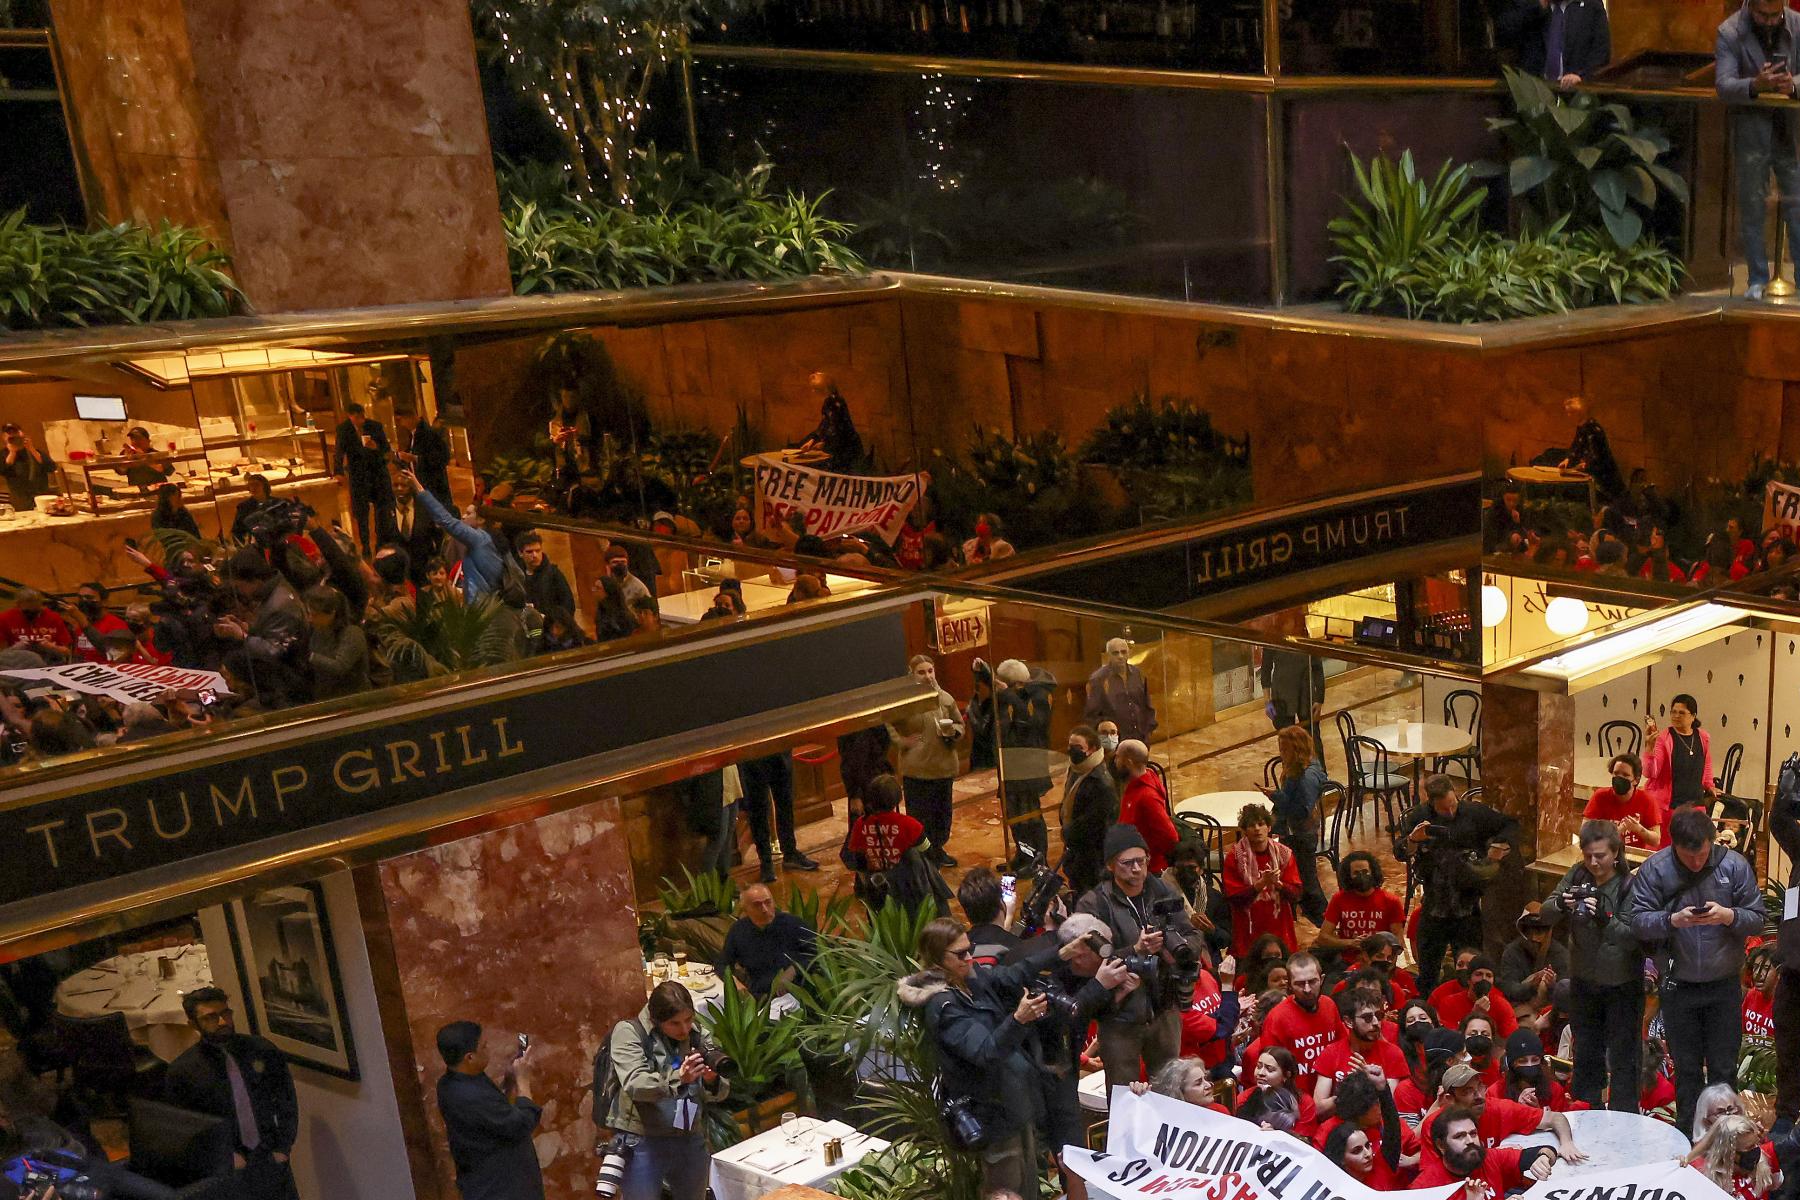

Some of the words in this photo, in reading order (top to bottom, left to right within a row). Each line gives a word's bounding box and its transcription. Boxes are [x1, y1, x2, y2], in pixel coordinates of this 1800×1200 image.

[756, 463, 807, 502] FREE
[941, 622, 972, 648] EXIT
[27, 765, 309, 869] TRUMP
[332, 716, 525, 794] GRILL
[862, 824, 900, 836] JEWS
[866, 837, 896, 847] SAY
[1341, 910, 1368, 919] NOT
[1370, 910, 1383, 919] IN
[1346, 920, 1376, 930] OUR
[1745, 1008, 1769, 1025] NOT
[1294, 1034, 1323, 1049] NOT
[1153, 1122, 1304, 1200] TRADITION
[1108, 1157, 1154, 1188] IS
